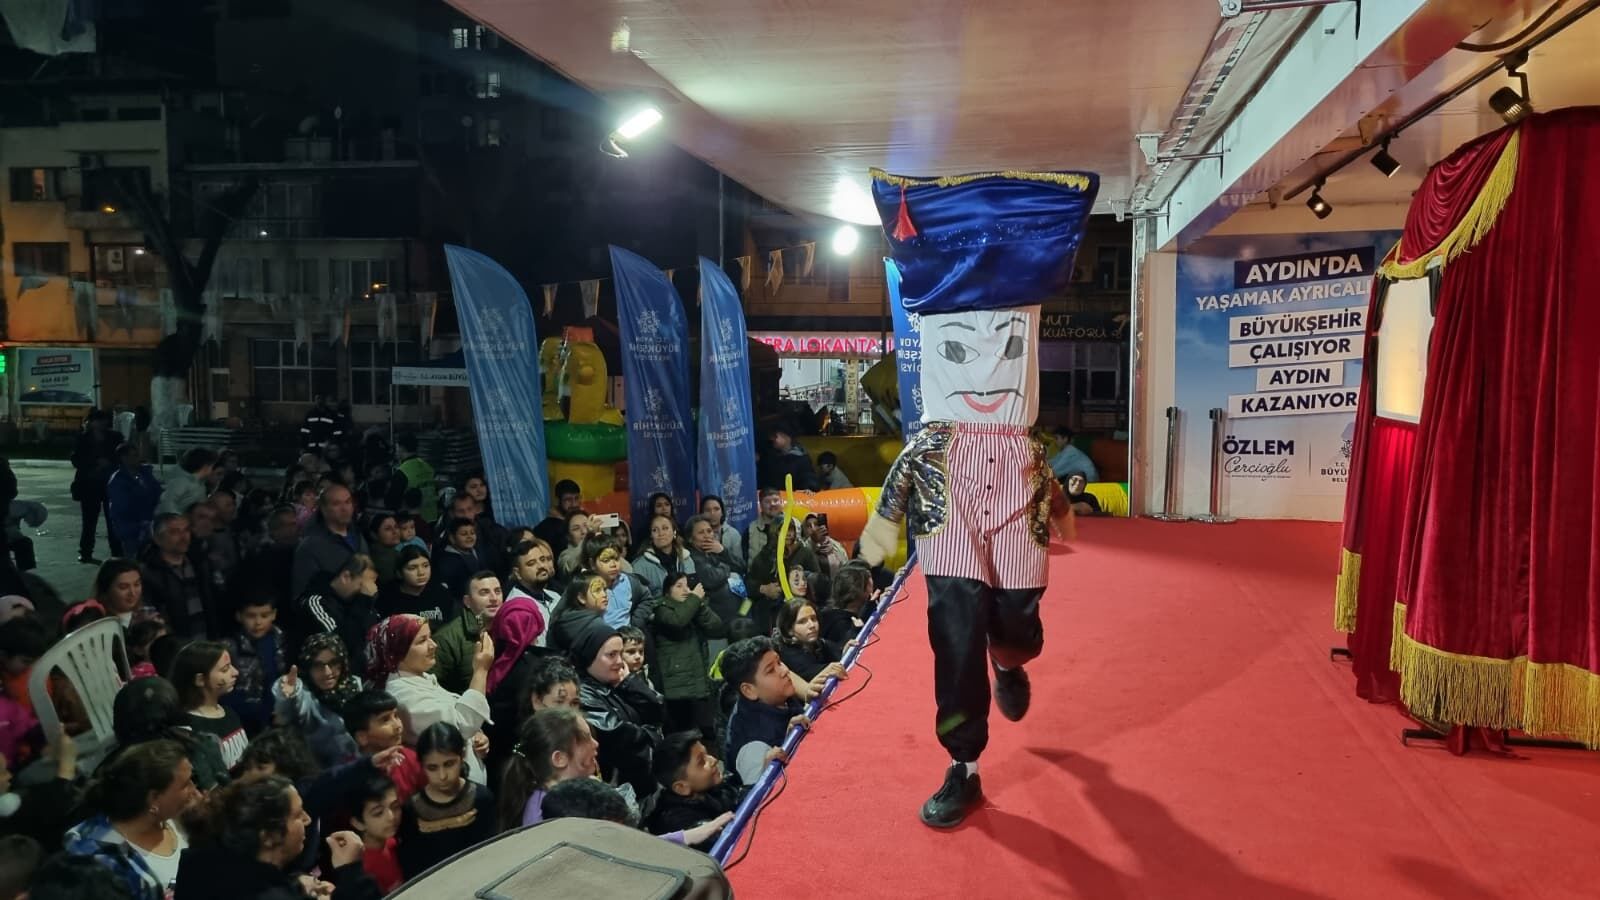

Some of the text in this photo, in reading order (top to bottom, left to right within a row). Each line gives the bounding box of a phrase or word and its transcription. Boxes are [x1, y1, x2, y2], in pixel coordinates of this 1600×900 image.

[1195, 289, 1284, 312] YAŞAMAK
[1240, 308, 1362, 337] BÜYÜKŞEHİR
[1250, 338, 1351, 363] ÇALIŞIYOR
[1269, 368, 1330, 385] AYDIN
[1241, 391, 1357, 413] KAZANIYOR
[1222, 435, 1295, 456] ÖZLEM
[1224, 455, 1291, 481] Cercioğlu
